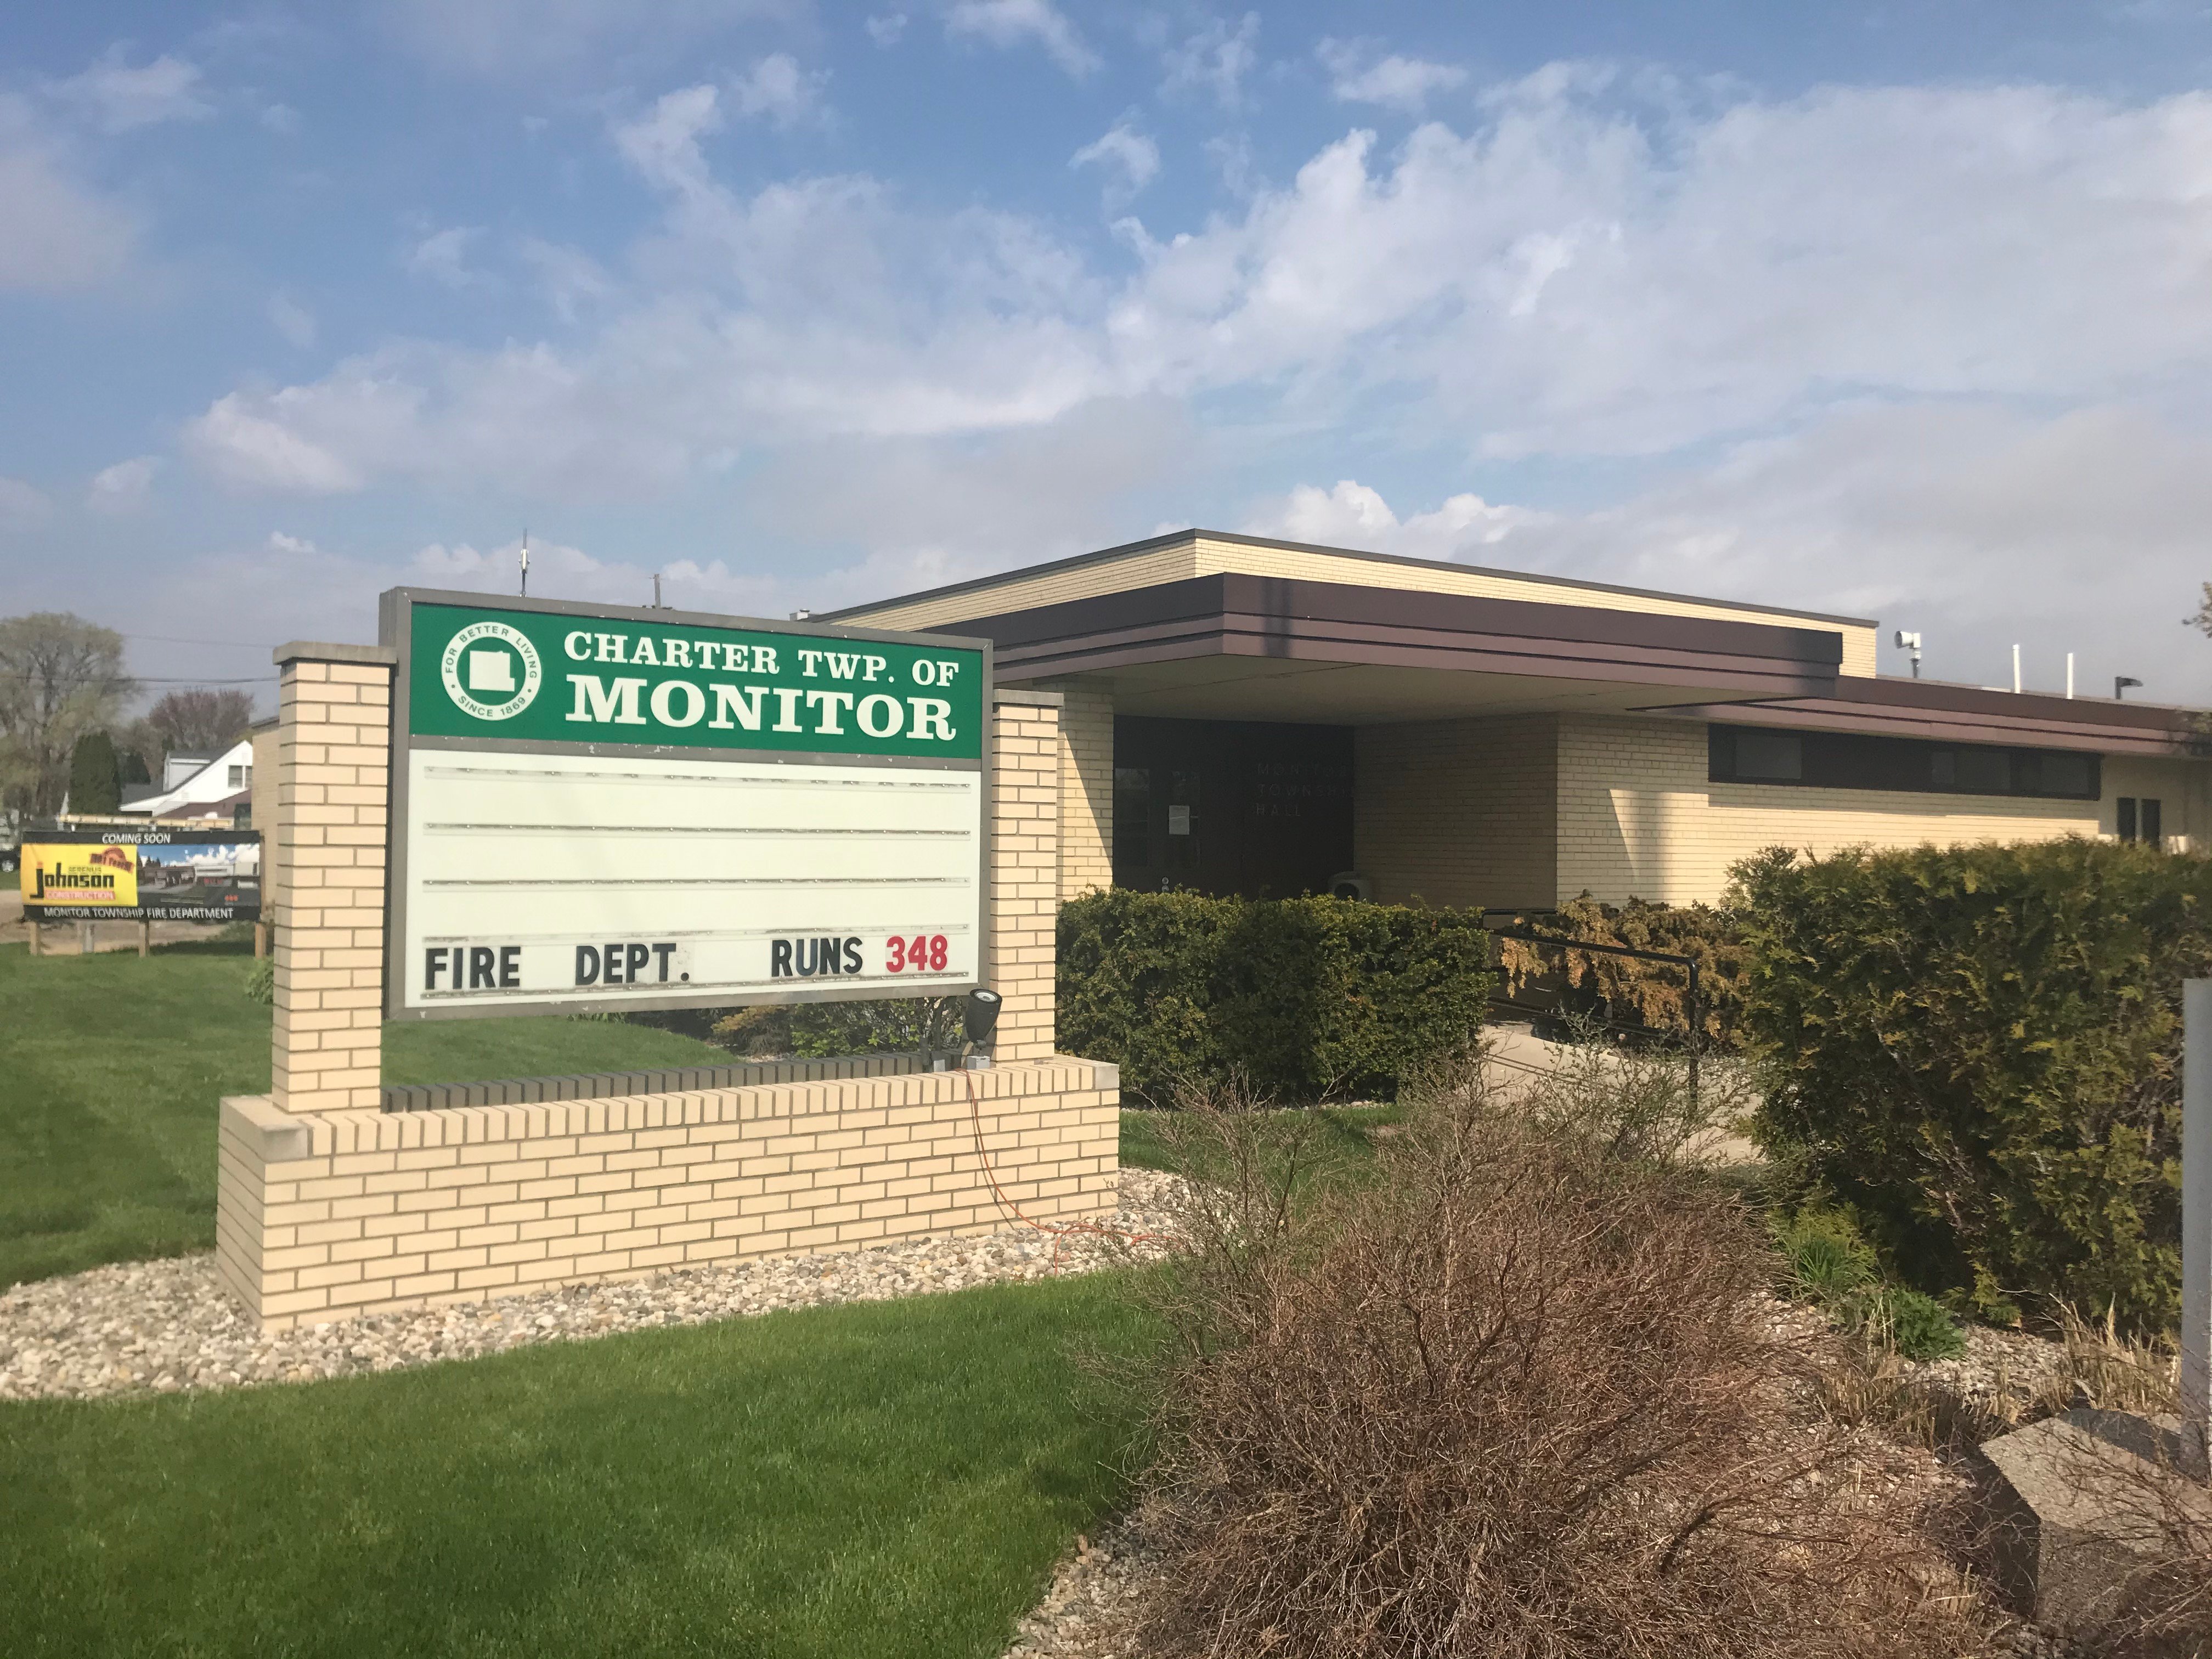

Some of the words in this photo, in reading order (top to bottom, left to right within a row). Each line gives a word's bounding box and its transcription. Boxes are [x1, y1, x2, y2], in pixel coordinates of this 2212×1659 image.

[445, 647, 458, 674] FOR
[459, 625, 509, 643] BETTER
[515, 637, 538, 679] LIVING
[564, 631, 780, 674] CHARTER
[798, 650, 895, 684] TWP.
[912, 659, 959, 687] OF
[458, 695, 493, 717] SINCE
[500, 697, 526, 715] 1869
[565, 674, 956, 741] MONITOR
[1257, 783, 1352, 798] TOWNSHI
[1256, 803, 1301, 817] HALL
[102, 833, 142, 844] COMING
[143, 833, 171, 844] SOON
[48, 891, 114, 900] CONSTRUCTION
[44, 907, 90, 918] MONITOR
[92, 907, 144, 918] TOWNSHIP
[147, 907, 167, 918] FIRE
[169, 907, 234, 919] DEPARTMENT
[425, 946, 521, 990] FIRE
[575, 943, 690, 986] DEPT.
[771, 937, 864, 977] RUNS
[886, 934, 948, 973] 348
